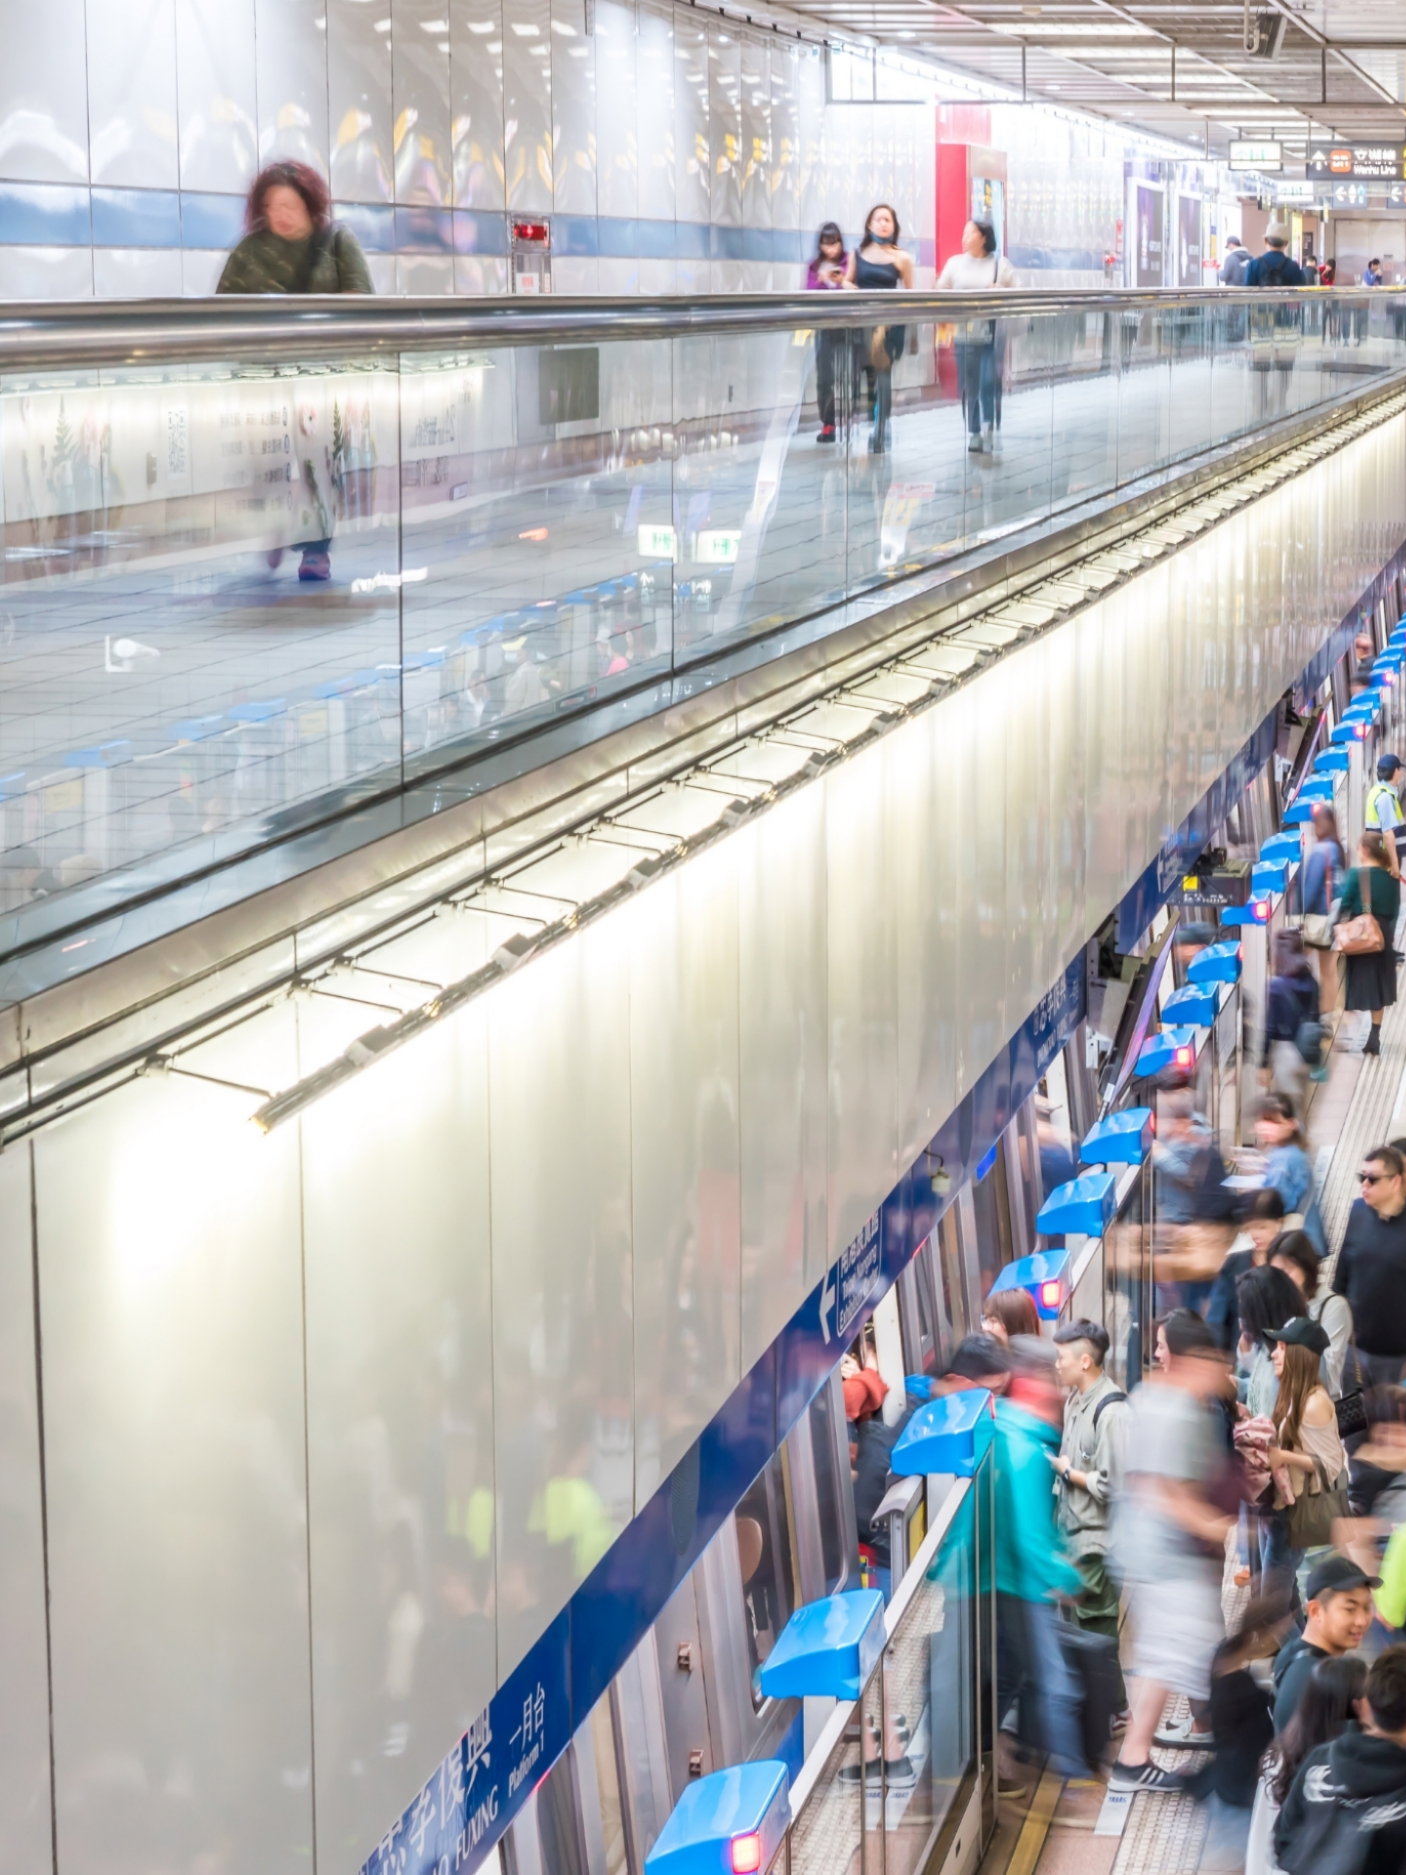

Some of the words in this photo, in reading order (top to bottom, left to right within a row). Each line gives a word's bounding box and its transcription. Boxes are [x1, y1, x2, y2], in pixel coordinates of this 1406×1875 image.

[509, 1681, 545, 1750] 一月台
[508, 1742, 539, 1798] Platform
[454, 1785, 499, 1871] FUXING
